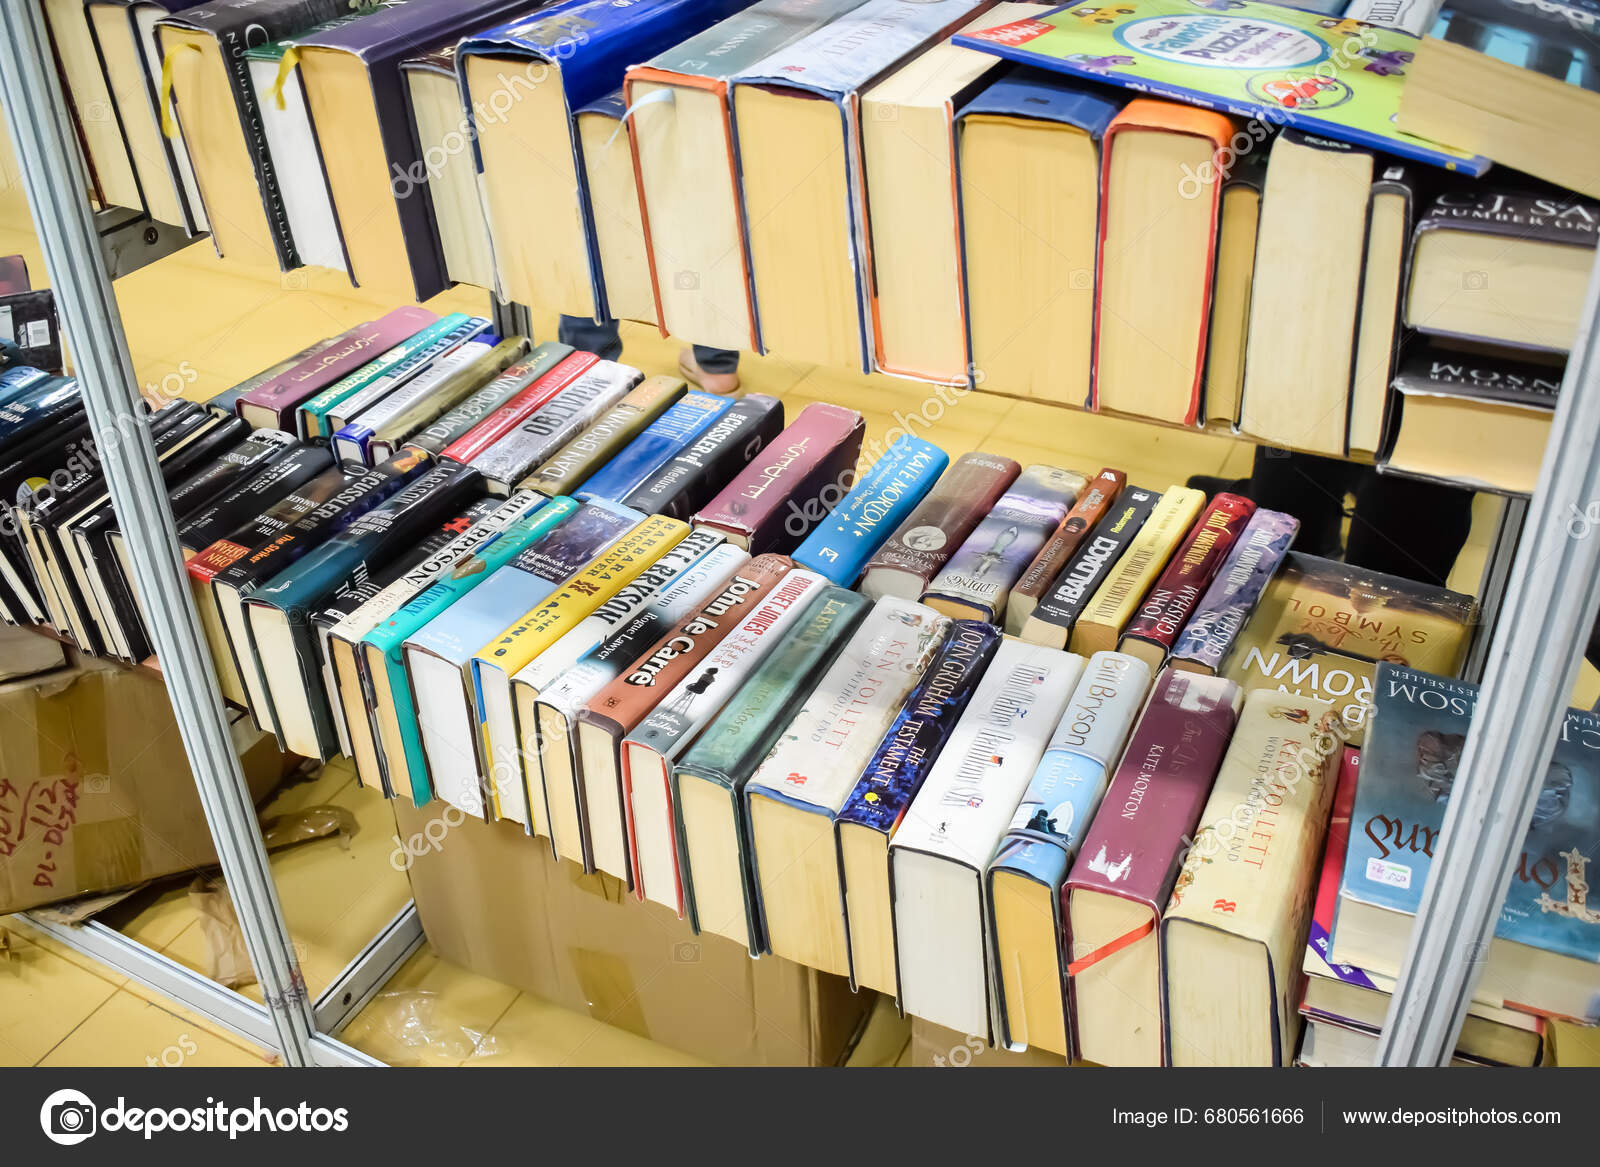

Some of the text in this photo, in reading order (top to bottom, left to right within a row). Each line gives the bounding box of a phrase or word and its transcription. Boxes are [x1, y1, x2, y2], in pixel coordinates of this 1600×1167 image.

[1141, 17, 1231, 52] Favorite
[1179, 24, 1269, 60] Puzzles
[464, 373, 523, 418] BROWN
[542, 450, 578, 479] DAN
[576, 404, 635, 455] BROWN
[740, 436, 812, 501] ELDEST
[318, 476, 381, 519] CUSSLER
[649, 465, 690, 494] Medusa
[855, 473, 910, 534] MORTON
[406, 524, 491, 587] BRYSON
[584, 516, 665, 577] KINGSOLVER
[598, 521, 677, 582] BARBARA
[670, 530, 715, 566] BILL
[1188, 527, 1221, 566] RUNAWAY
[587, 562, 679, 626] BRYSON
[654, 571, 709, 608] Grisham
[742, 574, 813, 637] BRIDGET JONES
[1140, 588, 1174, 621] JOHN
[1156, 585, 1200, 635] GRISHAM
[498, 591, 572, 645] LACUNA
[534, 614, 562, 634] THE
[598, 611, 660, 662] Rogue Lawyer
[622, 574, 762, 690] John le Carré
[1187, 610, 1214, 643] JOHN
[1204, 606, 1246, 657] GRISHAM
[1287, 596, 1429, 645] SYMBOL
[918, 630, 986, 718] JOHN GRISHAM
[1241, 646, 1373, 707] ROWN
[824, 675, 884, 752] FOLLETT
[1063, 655, 1132, 749] Bill Bryson
[869, 719, 925, 788] TESTAMENT
[903, 746, 928, 767] THE
[1119, 742, 1166, 822] KATE MORTON
[1243, 782, 1289, 872] FOLLETT
